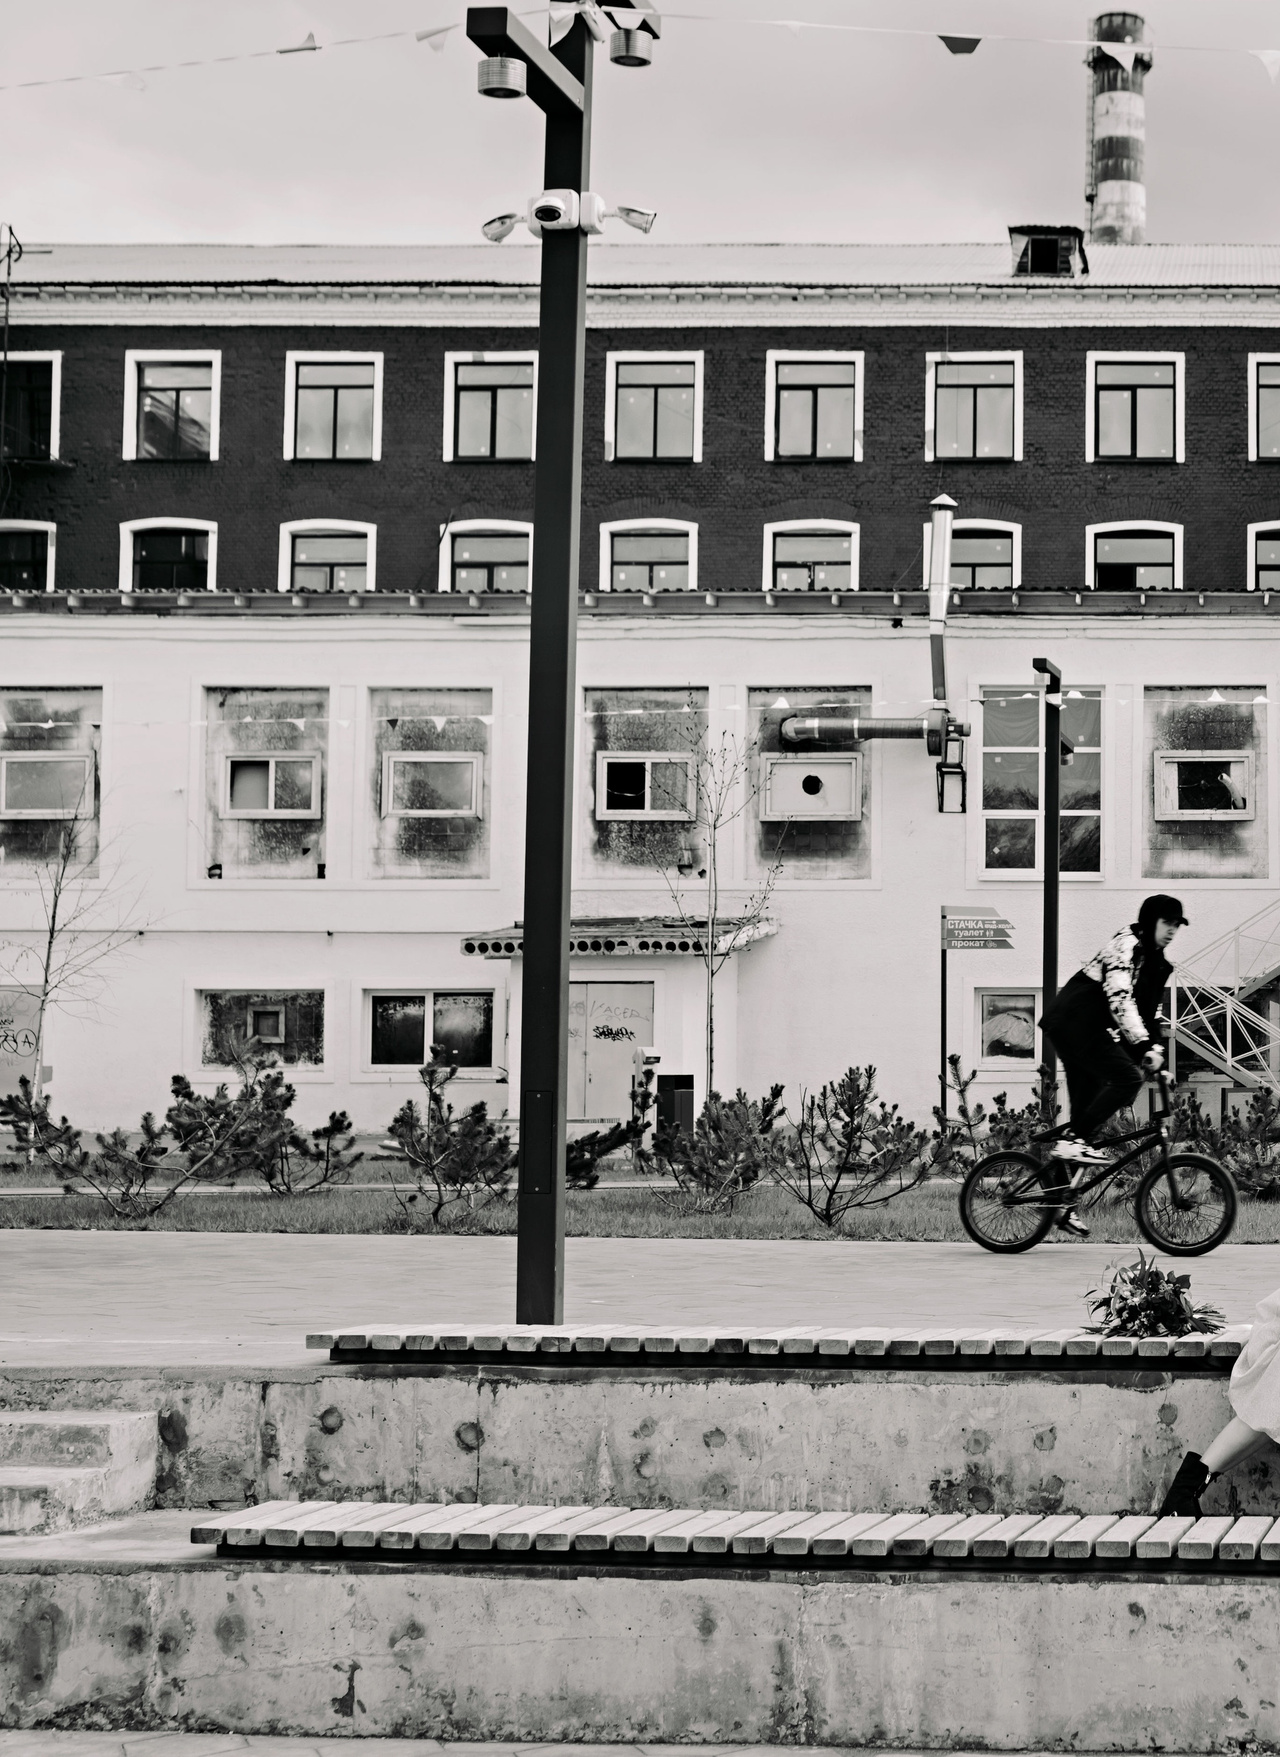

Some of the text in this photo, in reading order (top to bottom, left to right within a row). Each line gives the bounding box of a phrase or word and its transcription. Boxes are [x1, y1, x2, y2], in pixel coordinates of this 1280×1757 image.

[948, 921, 983, 929] СТАЧКА
[954, 930, 984, 938] туалет
[951, 940, 984, 948] прокат
